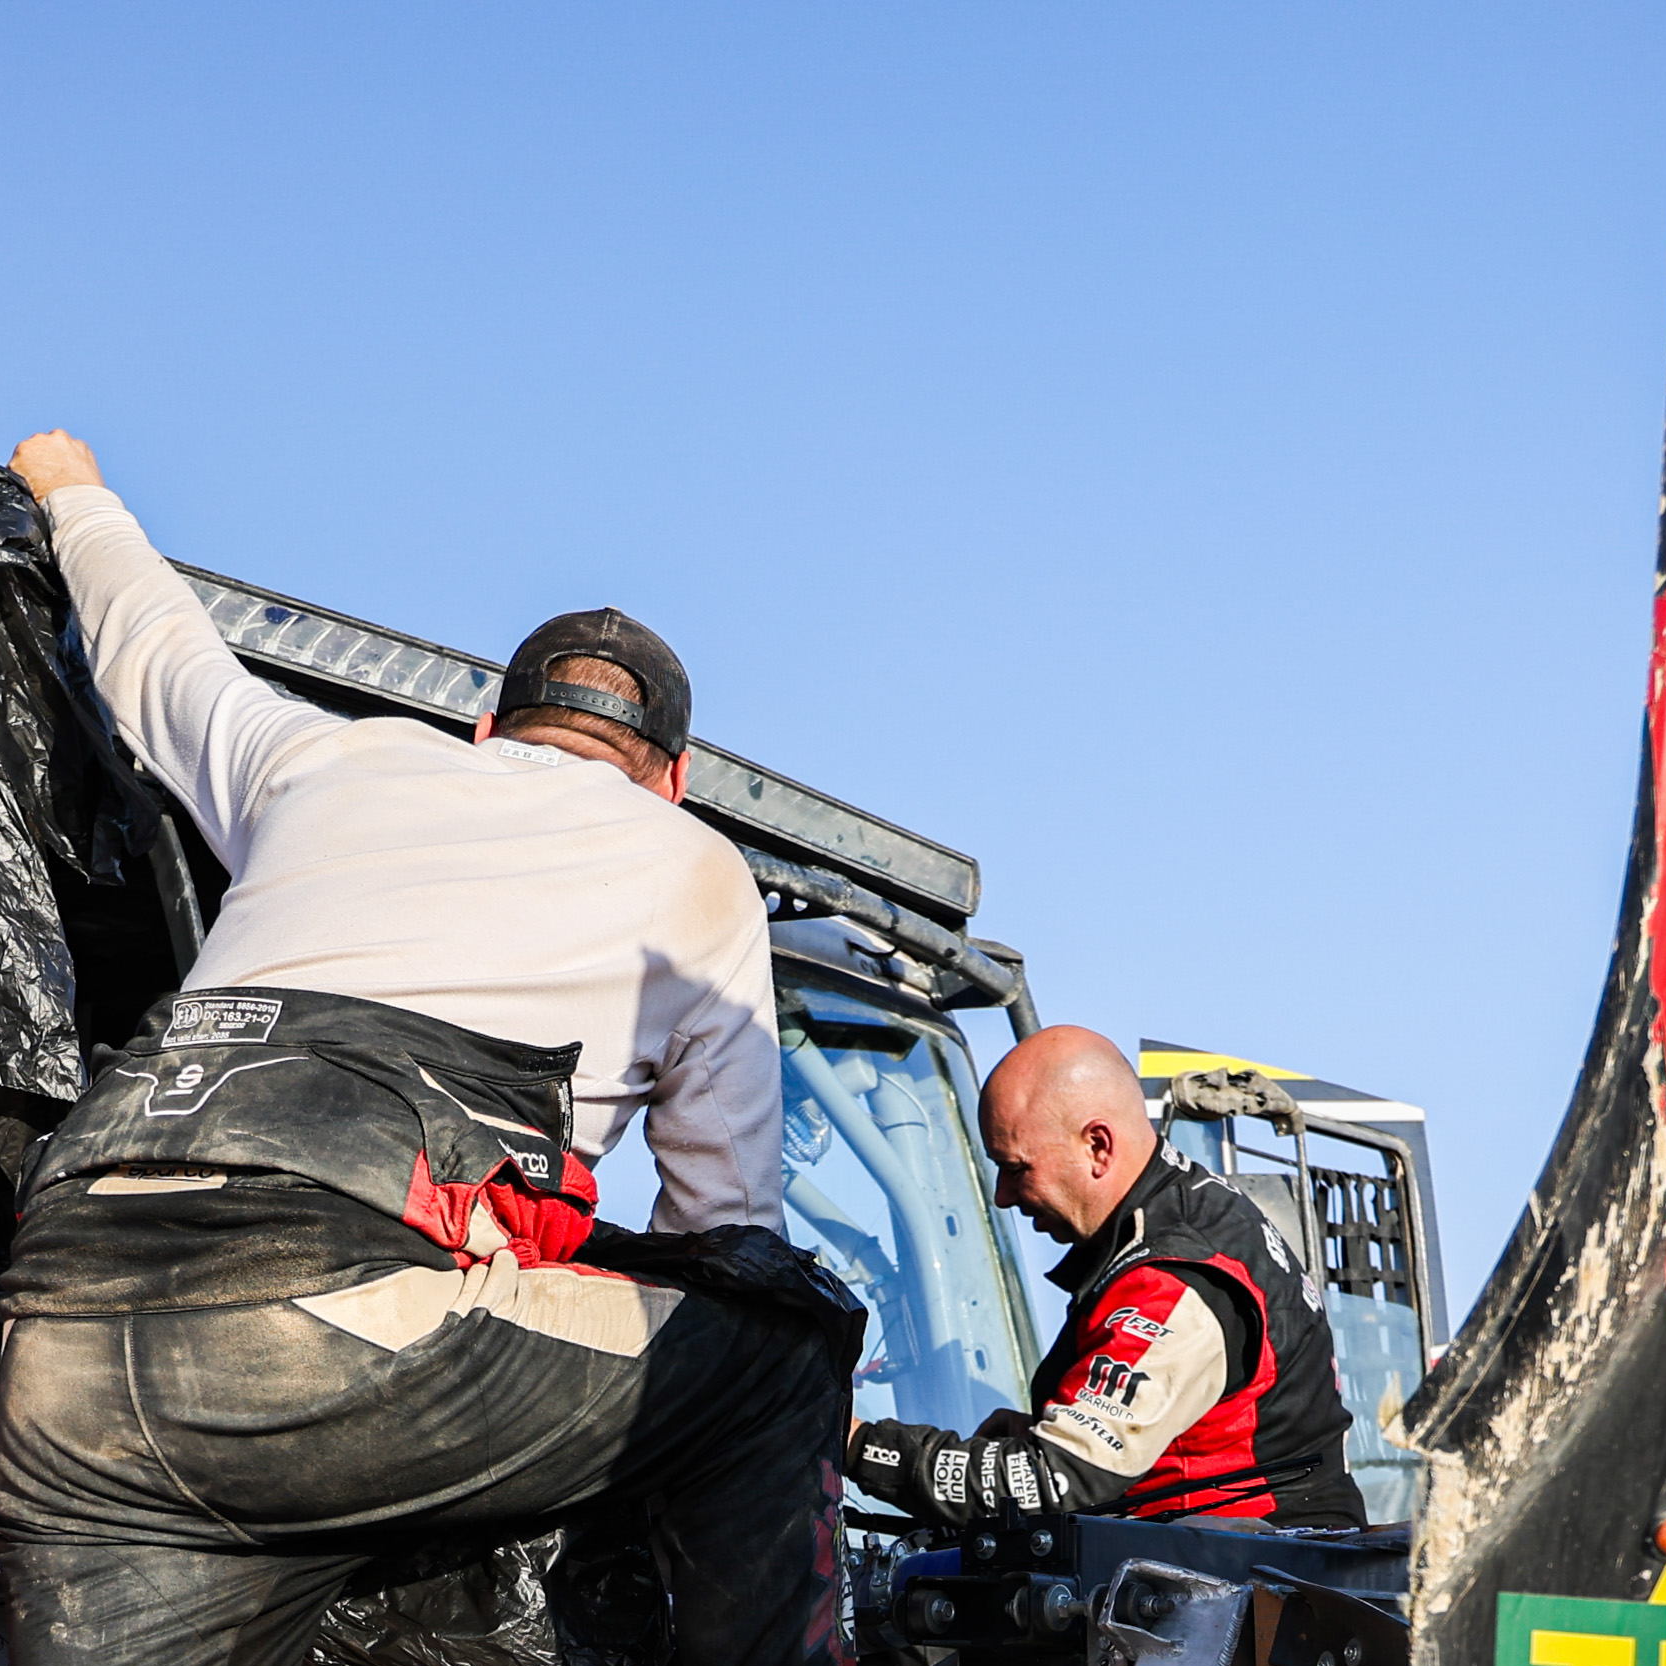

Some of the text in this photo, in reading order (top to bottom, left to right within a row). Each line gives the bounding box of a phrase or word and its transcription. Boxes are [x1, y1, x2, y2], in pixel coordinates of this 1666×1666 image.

[1128, 1316, 1175, 1339] FPT
[936, 1453, 950, 1500] MOLY
[951, 1452, 964, 1501] LIQUI
